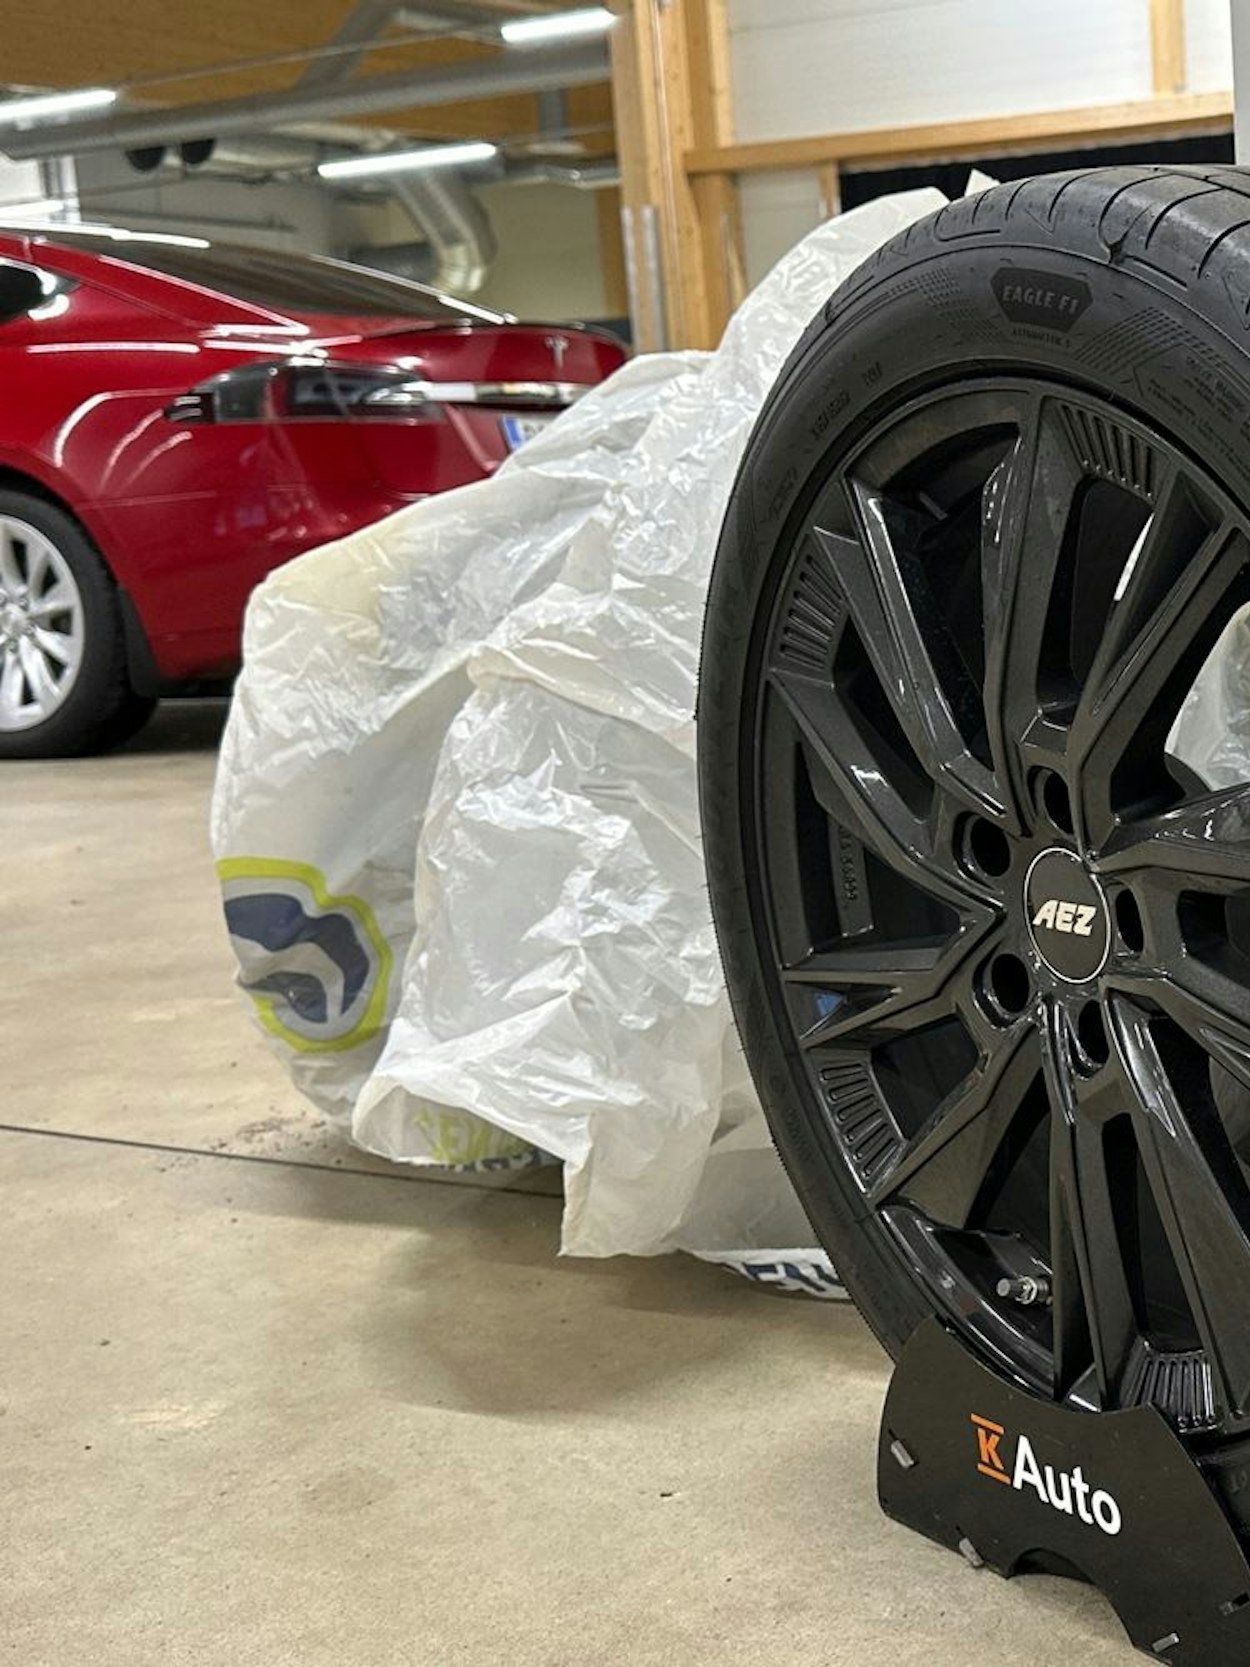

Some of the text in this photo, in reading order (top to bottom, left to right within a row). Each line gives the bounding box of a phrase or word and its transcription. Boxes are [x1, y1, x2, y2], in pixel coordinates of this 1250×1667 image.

[1003, 285, 1055, 308] EAGLE
[1032, 899, 1097, 937] AEZ
[1012, 1434, 1122, 1535] Auto
